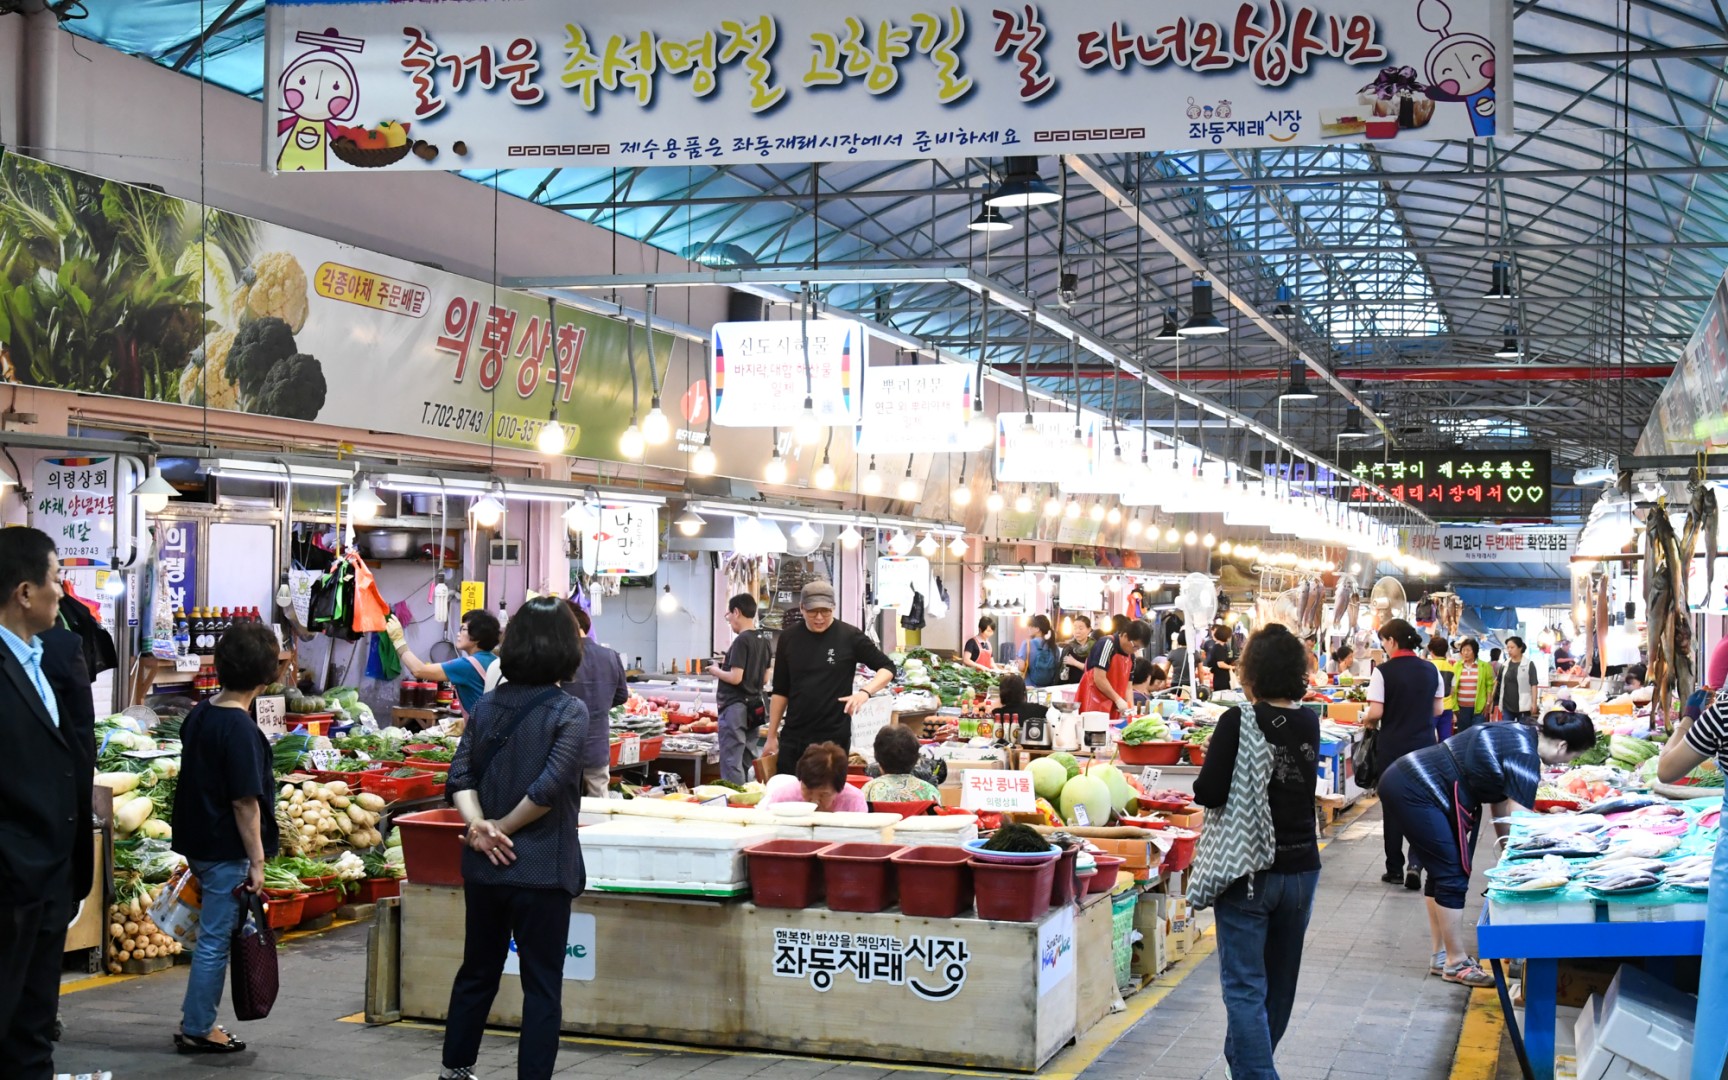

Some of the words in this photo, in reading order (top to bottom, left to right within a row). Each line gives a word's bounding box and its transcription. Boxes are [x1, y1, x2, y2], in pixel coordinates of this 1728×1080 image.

[401, 27, 541, 116] 즐거운
[561, 15, 782, 109] 추석명절
[803, 6, 969, 100] 고향길
[994, 5, 1049, 97] 잘
[1078, 1, 1386, 82] 다녀오십시오
[1188, 110, 1302, 144] 좌동재래시장
[620, 136, 723, 159] 제수용품은
[732, 133, 902, 156] 좌동재래시장에서
[913, 128, 1020, 152] 준비하세요
[322, 267, 374, 303] 각종야채
[376, 283, 425, 314] 주문배달
[437, 297, 586, 401] 의령상회
[47, 469, 108, 489] 의령상회
[1437, 461, 1534, 479] 제수용품은
[63, 520, 91, 542] 배달
[1443, 534, 1482, 551] 예고없다
[1527, 534, 1568, 551] 확인점검
[970, 776, 993, 791] 국산
[996, 777, 1030, 793] 콩나물
[986, 797, 1018, 808] 의령상회
[776, 930, 811, 945] 행복한
[816, 934, 850, 948] 밥상을
[856, 936, 902, 951] 책임지는
[776, 938, 968, 989] 좌동재래시장
